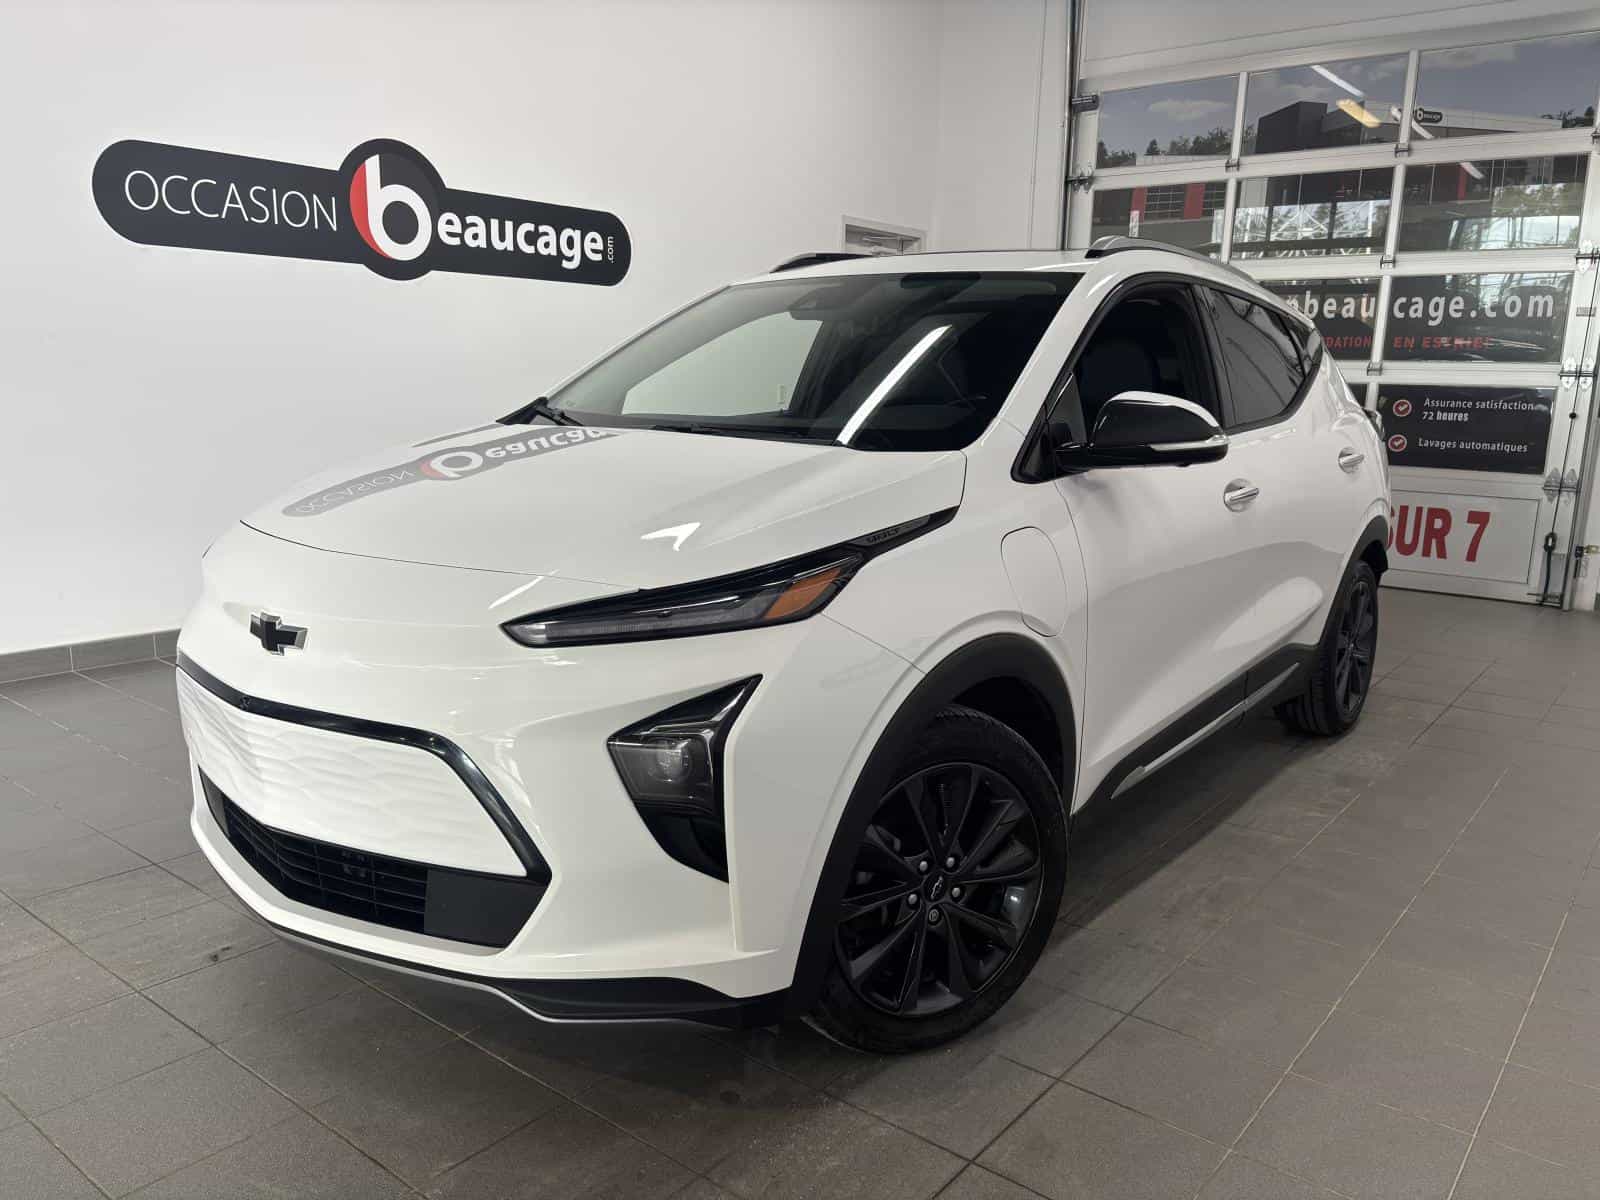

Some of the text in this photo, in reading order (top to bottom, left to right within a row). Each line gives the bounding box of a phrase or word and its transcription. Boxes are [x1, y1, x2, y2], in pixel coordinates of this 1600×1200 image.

[125, 154, 604, 269] OCCASION beaucage
[1393, 336, 1415, 348] EN
[1424, 398, 1534, 411] Assurance satisfaction
[1422, 411, 1469, 421] 72 heures
[1418, 438, 1528, 453] Lavages automatiques
[1386, 505, 1491, 562] UR 7
